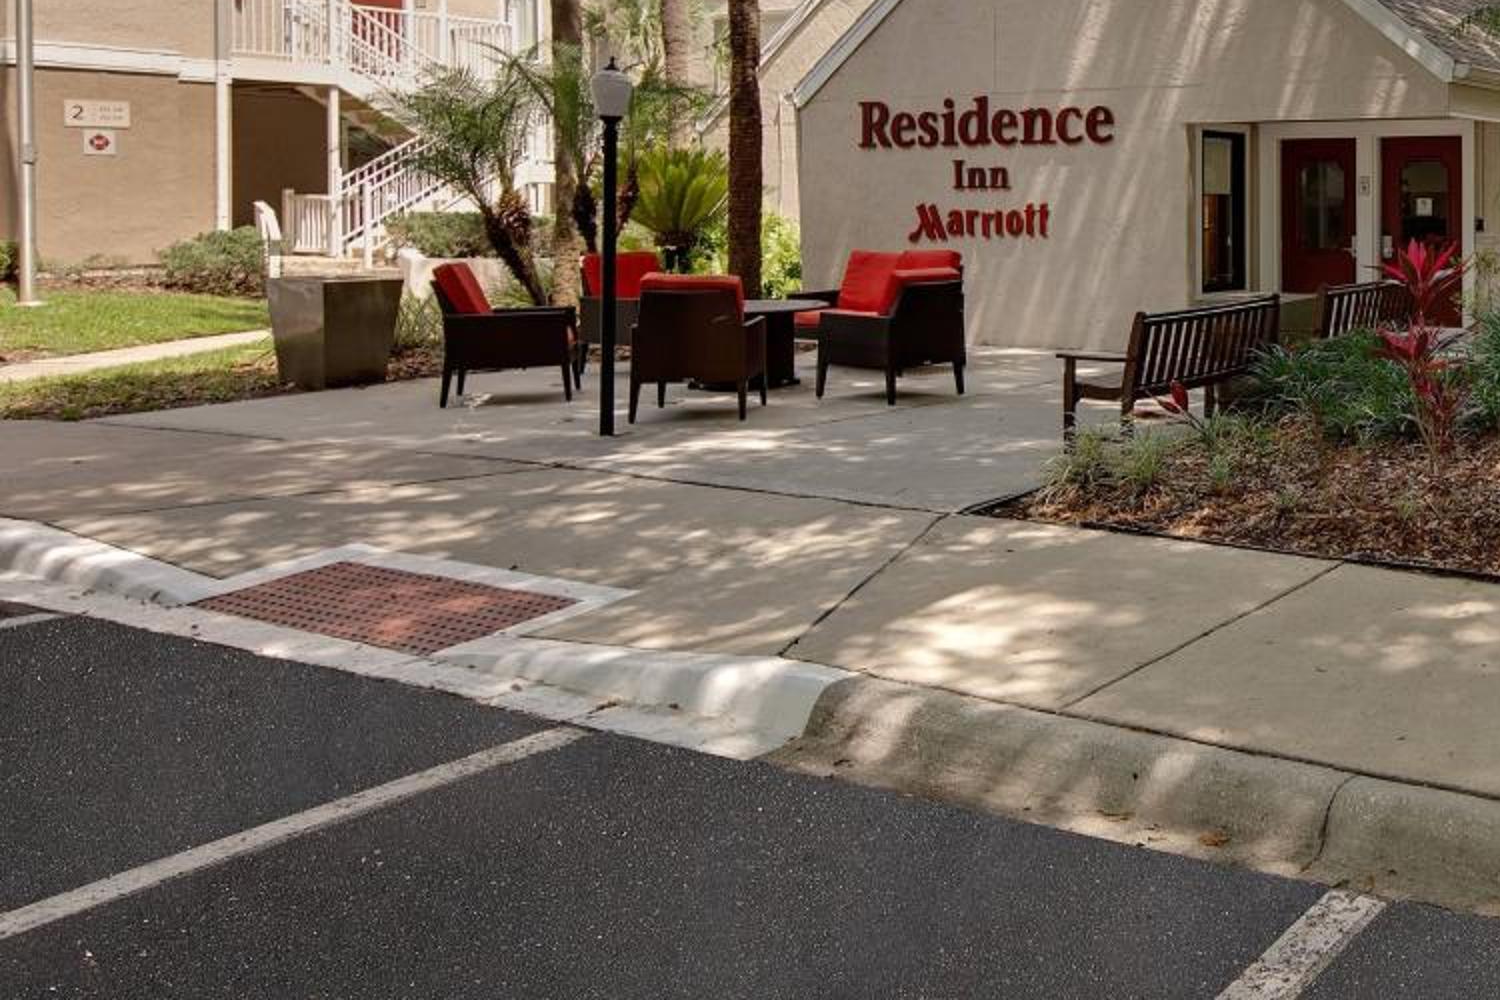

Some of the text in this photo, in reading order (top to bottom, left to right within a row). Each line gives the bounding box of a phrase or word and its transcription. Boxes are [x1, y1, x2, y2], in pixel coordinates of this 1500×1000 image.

[858, 95, 1115, 149] Residence
[952, 159, 1011, 190] Inn
[908, 203, 1050, 243] Marriott
